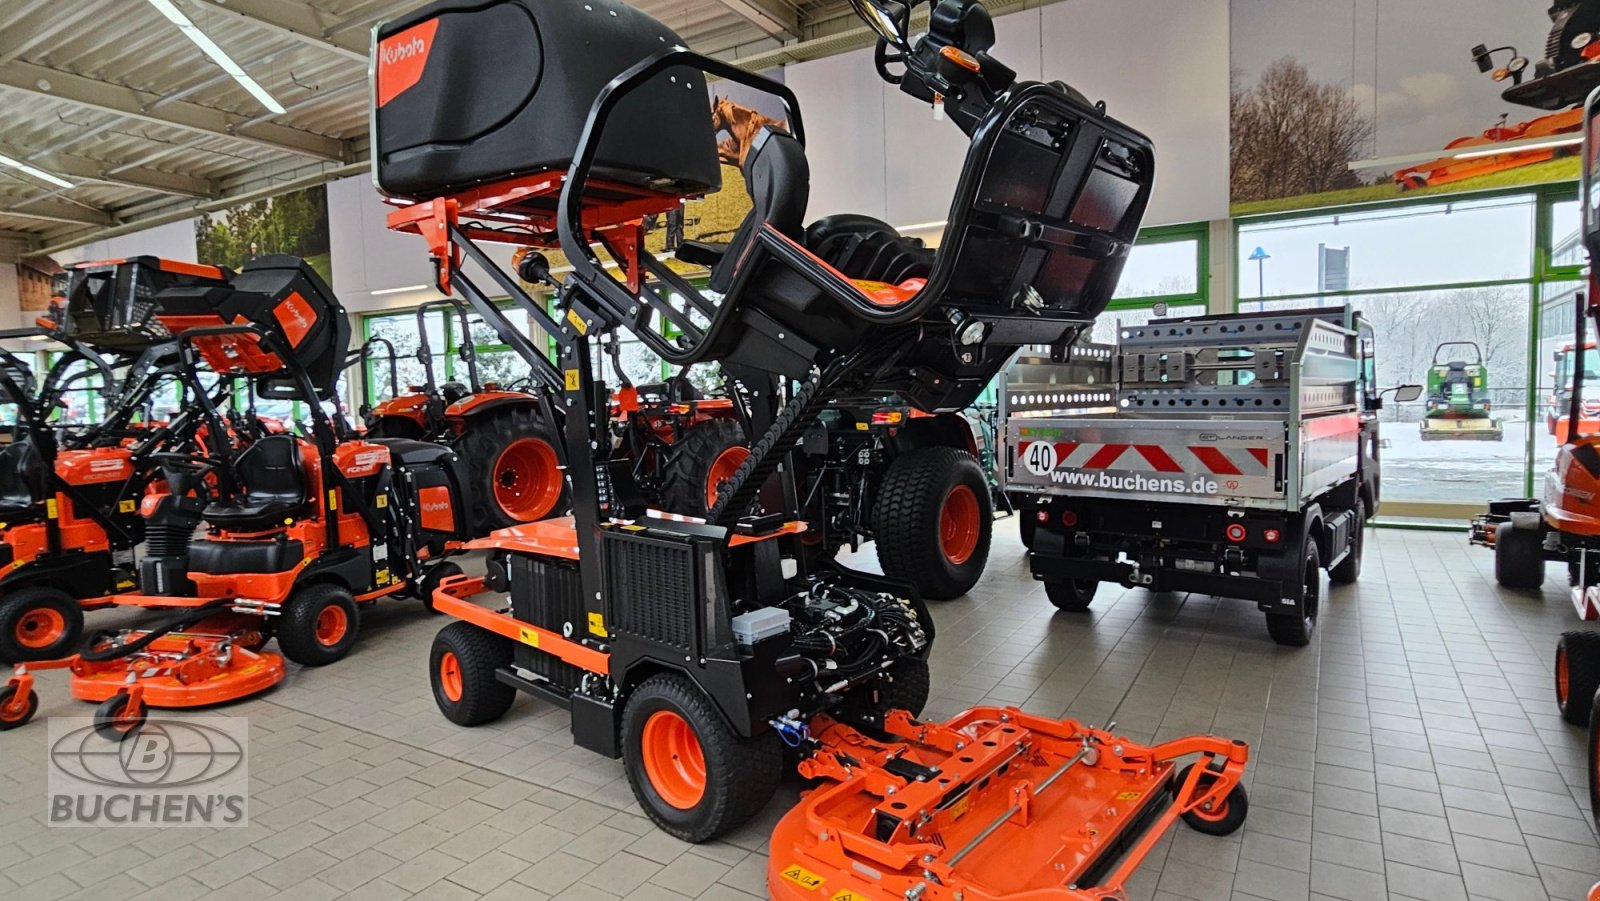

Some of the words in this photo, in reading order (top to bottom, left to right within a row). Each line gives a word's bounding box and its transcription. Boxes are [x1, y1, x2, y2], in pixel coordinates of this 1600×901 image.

[383, 36, 424, 64] Kubota
[1030, 445, 1051, 471] 40
[1050, 470, 1218, 494] www.buchens.de
